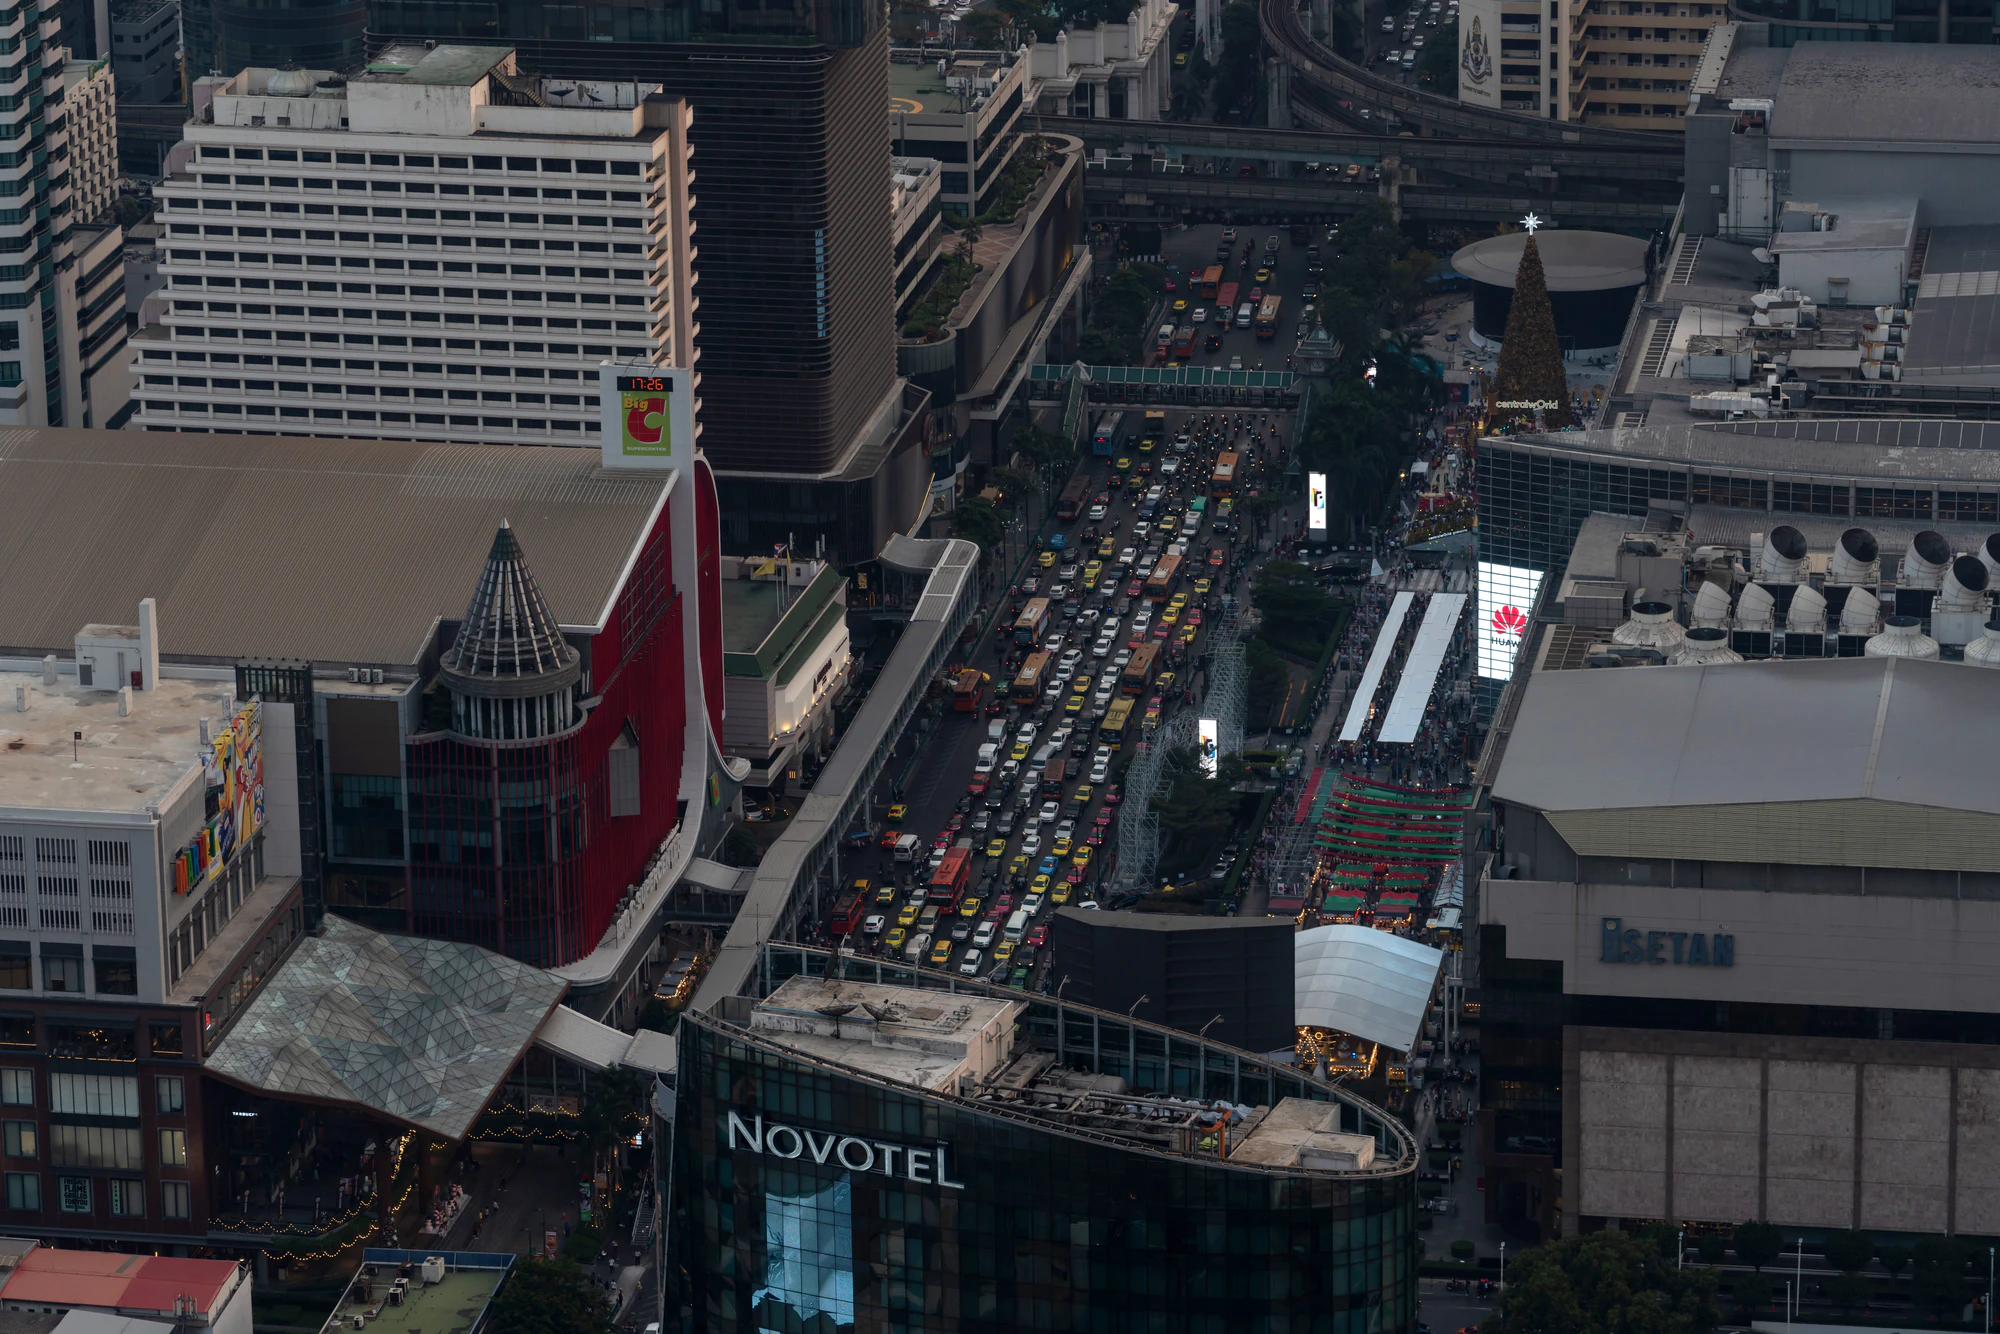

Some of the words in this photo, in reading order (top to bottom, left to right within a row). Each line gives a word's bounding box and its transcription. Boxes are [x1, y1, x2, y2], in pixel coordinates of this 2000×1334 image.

[631, 377, 664, 391] 17:26
[624, 397, 649, 412] Big
[627, 398, 666, 444] C
[1491, 636, 1521, 648] HUAW
[175, 822, 217, 895] MARKET
[728, 1109, 967, 1190] NOVOTEL
[64, 1185, 87, 1193] FLAME
